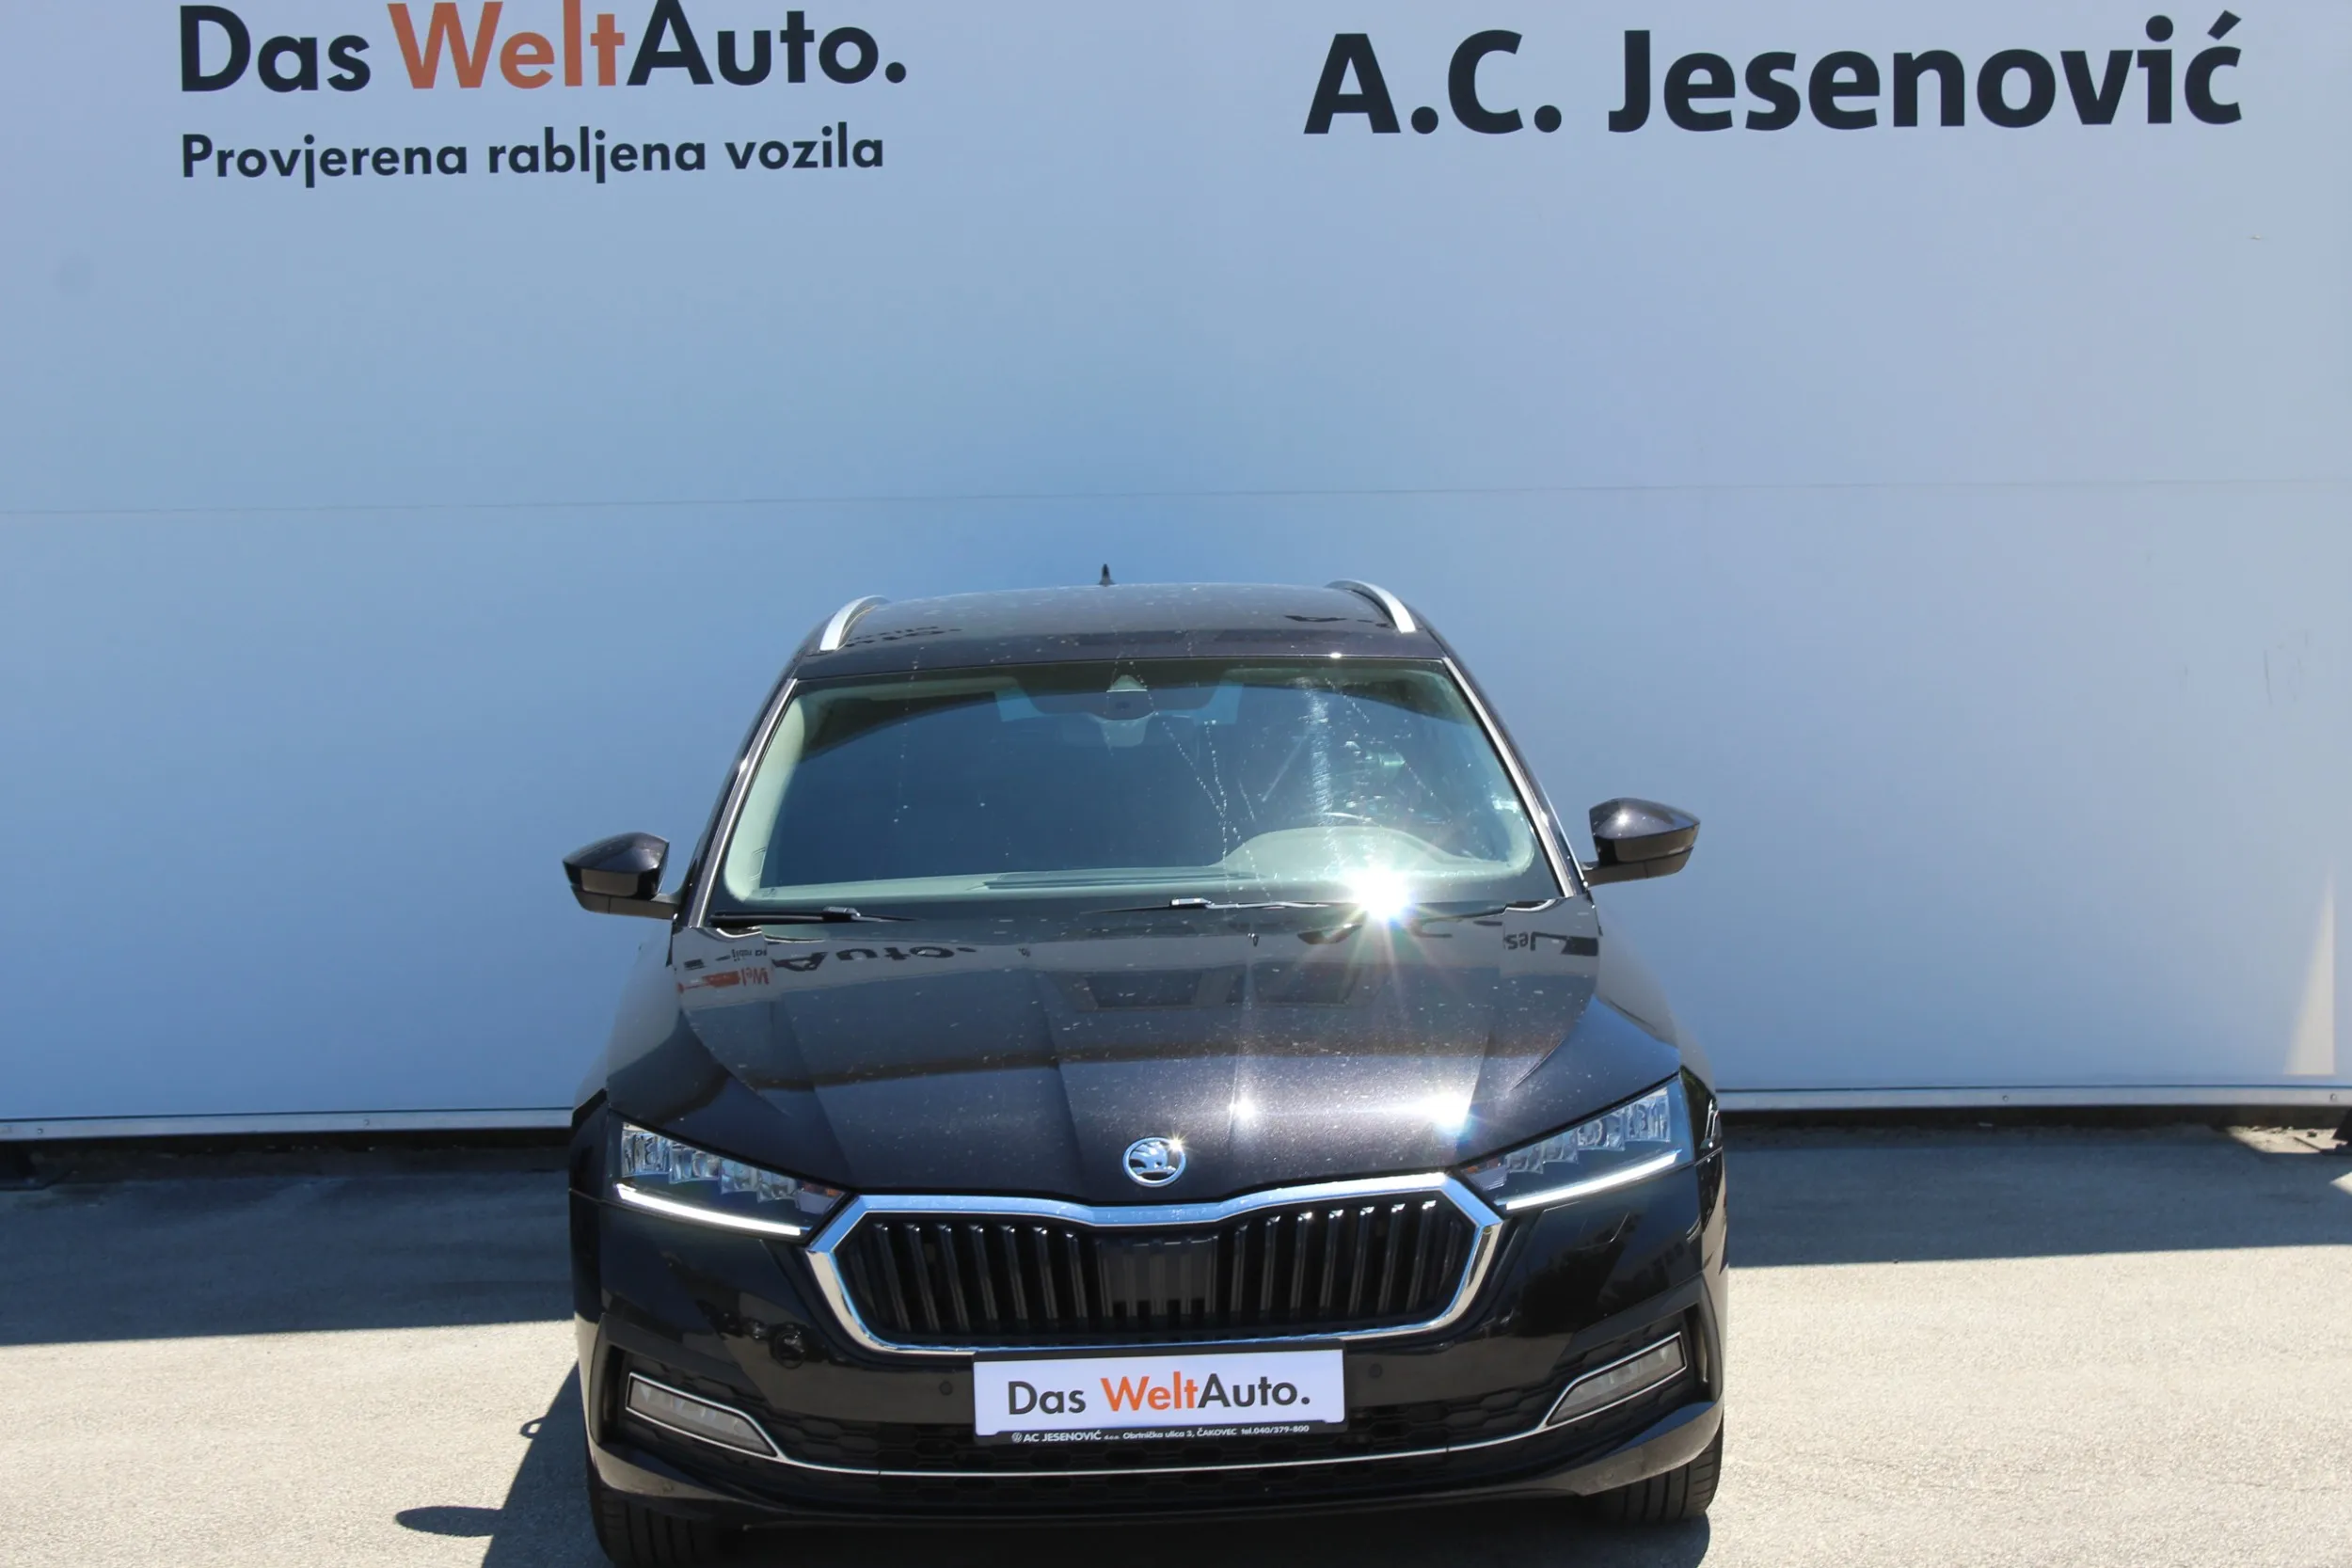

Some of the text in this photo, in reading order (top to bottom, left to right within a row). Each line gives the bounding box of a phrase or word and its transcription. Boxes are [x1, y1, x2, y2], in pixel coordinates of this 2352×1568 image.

[181, 0, 907, 92] Das WeltAuto.
[1304, 9, 2243, 135] A.C. Jesenović
[183, 121, 883, 188] Provjerena rabljena vozila
[1008, 1370, 1311, 1416] Das WeltAuto.
[1023, 1433, 1040, 1443] AC
[1041, 1429, 1102, 1442] JESENOVIĆ
[1165, 1429, 1184, 1438] ulica
[1196, 1427, 1237, 1437] ČAKOVEC
